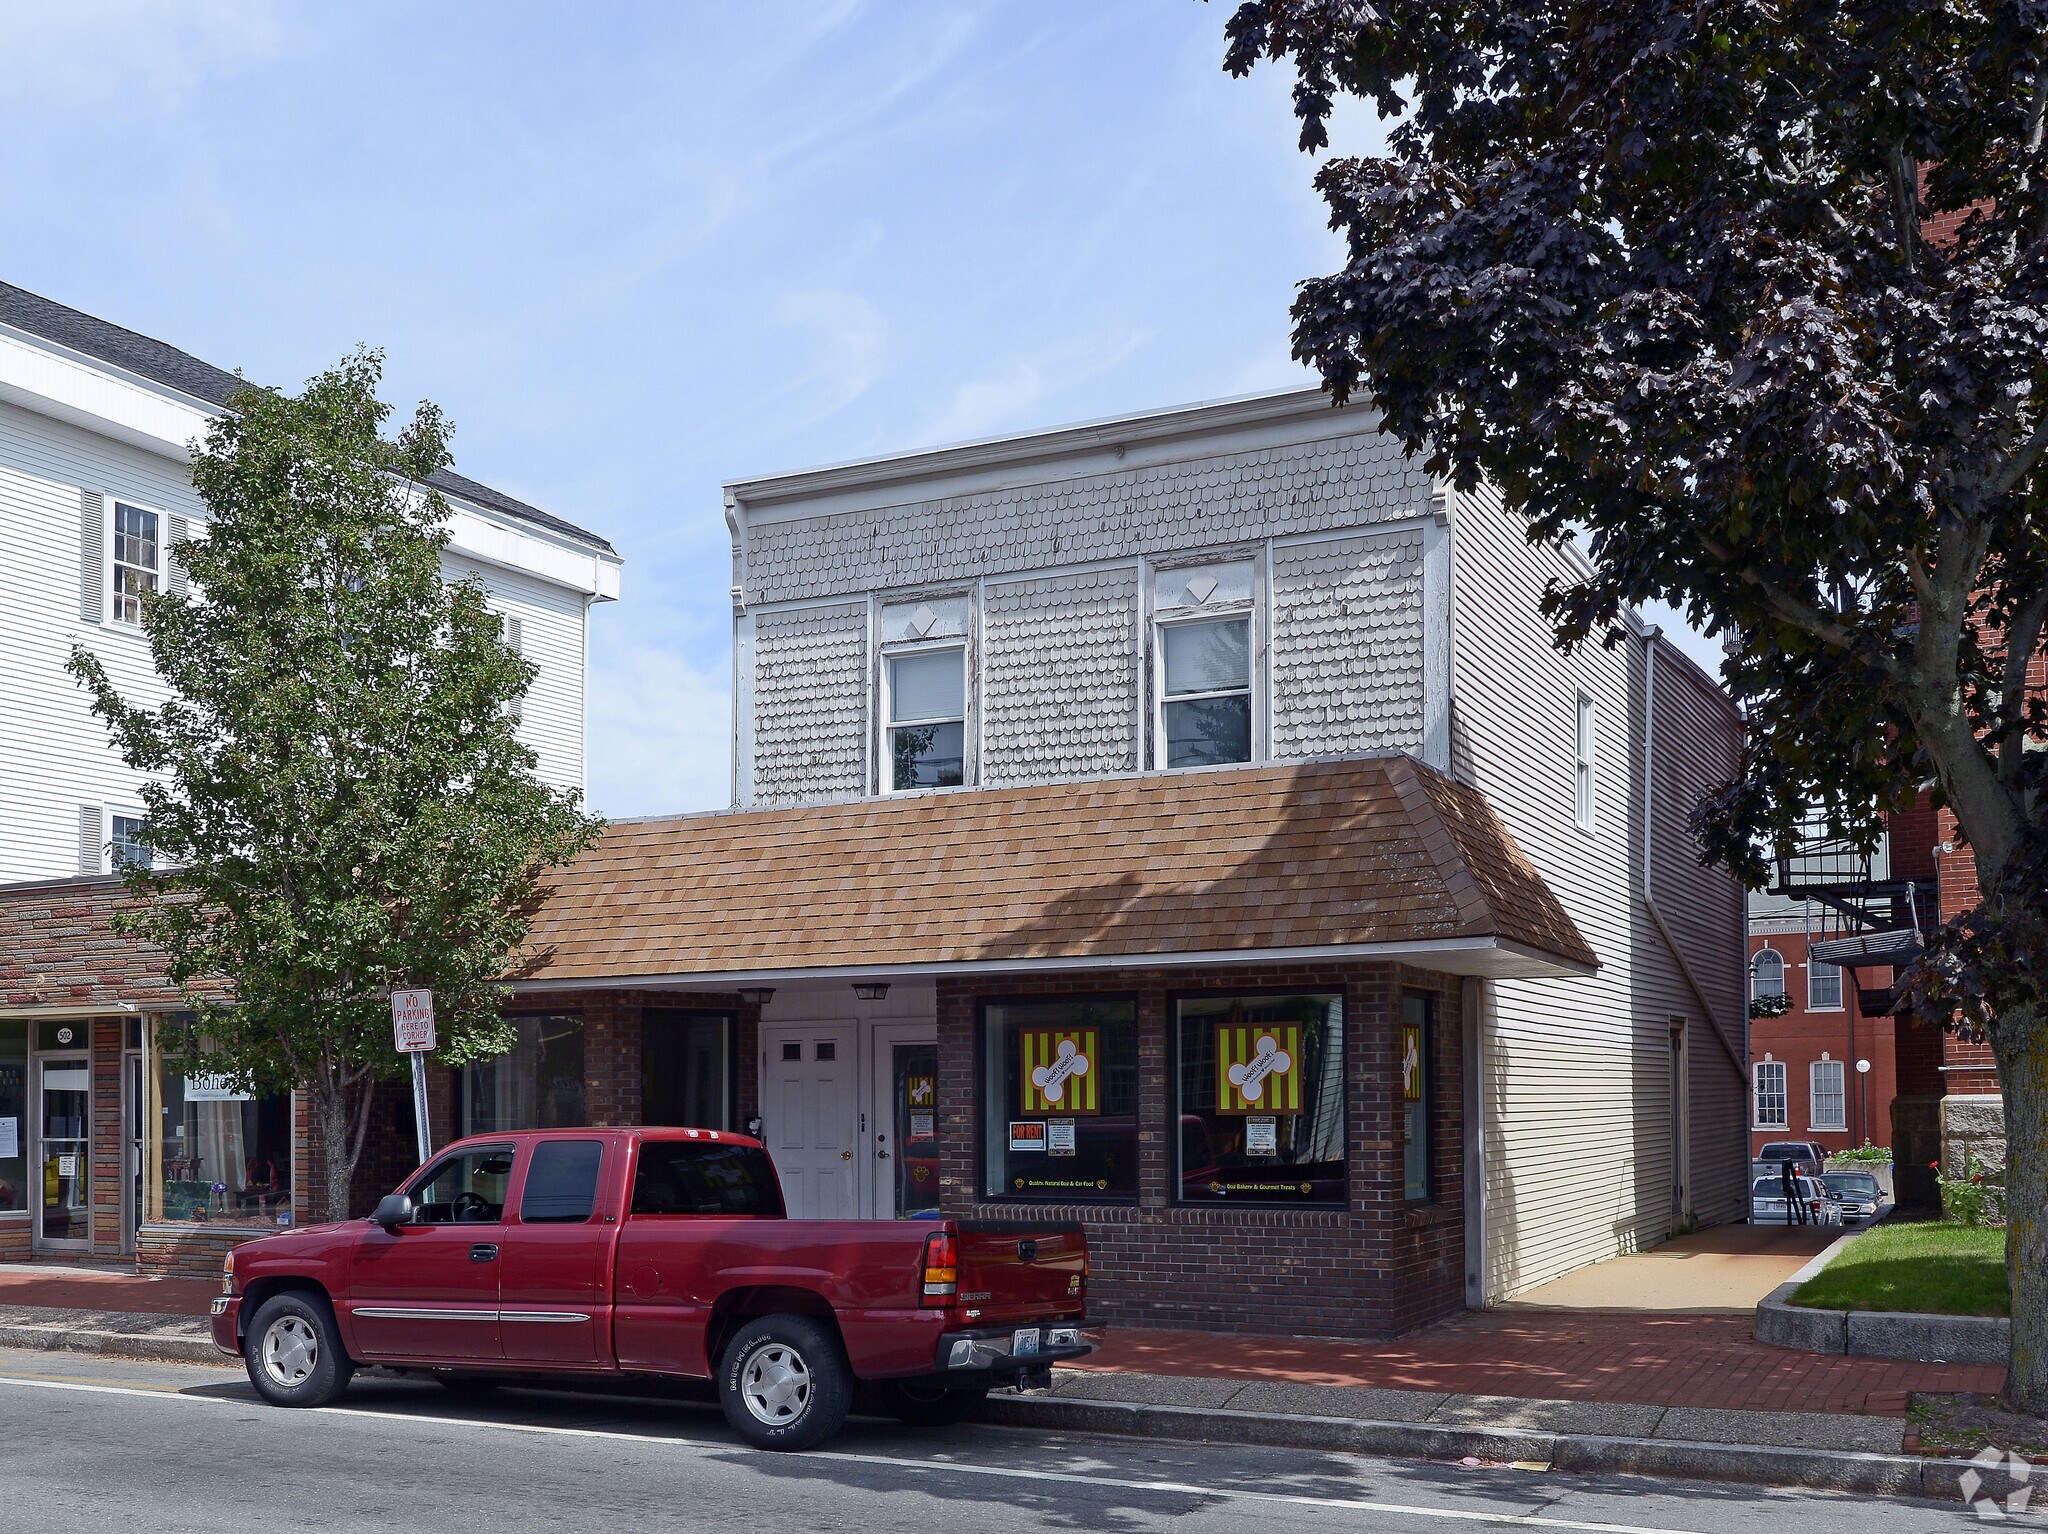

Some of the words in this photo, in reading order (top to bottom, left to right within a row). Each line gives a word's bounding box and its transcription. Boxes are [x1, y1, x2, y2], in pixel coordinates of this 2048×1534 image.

[405, 996, 418, 1007] NO
[397, 1008, 429, 1021] PARKING
[401, 1022, 418, 1031] HERE
[420, 1021, 429, 1029] TO
[60, 1031, 71, 1040] 502
[402, 1031, 428, 1040] CORNER
[1012, 1124, 1025, 1139] FOR
[1026, 1124, 1042, 1139] RENT
[960, 1292, 991, 1301] SIERRA
[729, 1333, 772, 1391] MICHELIN
